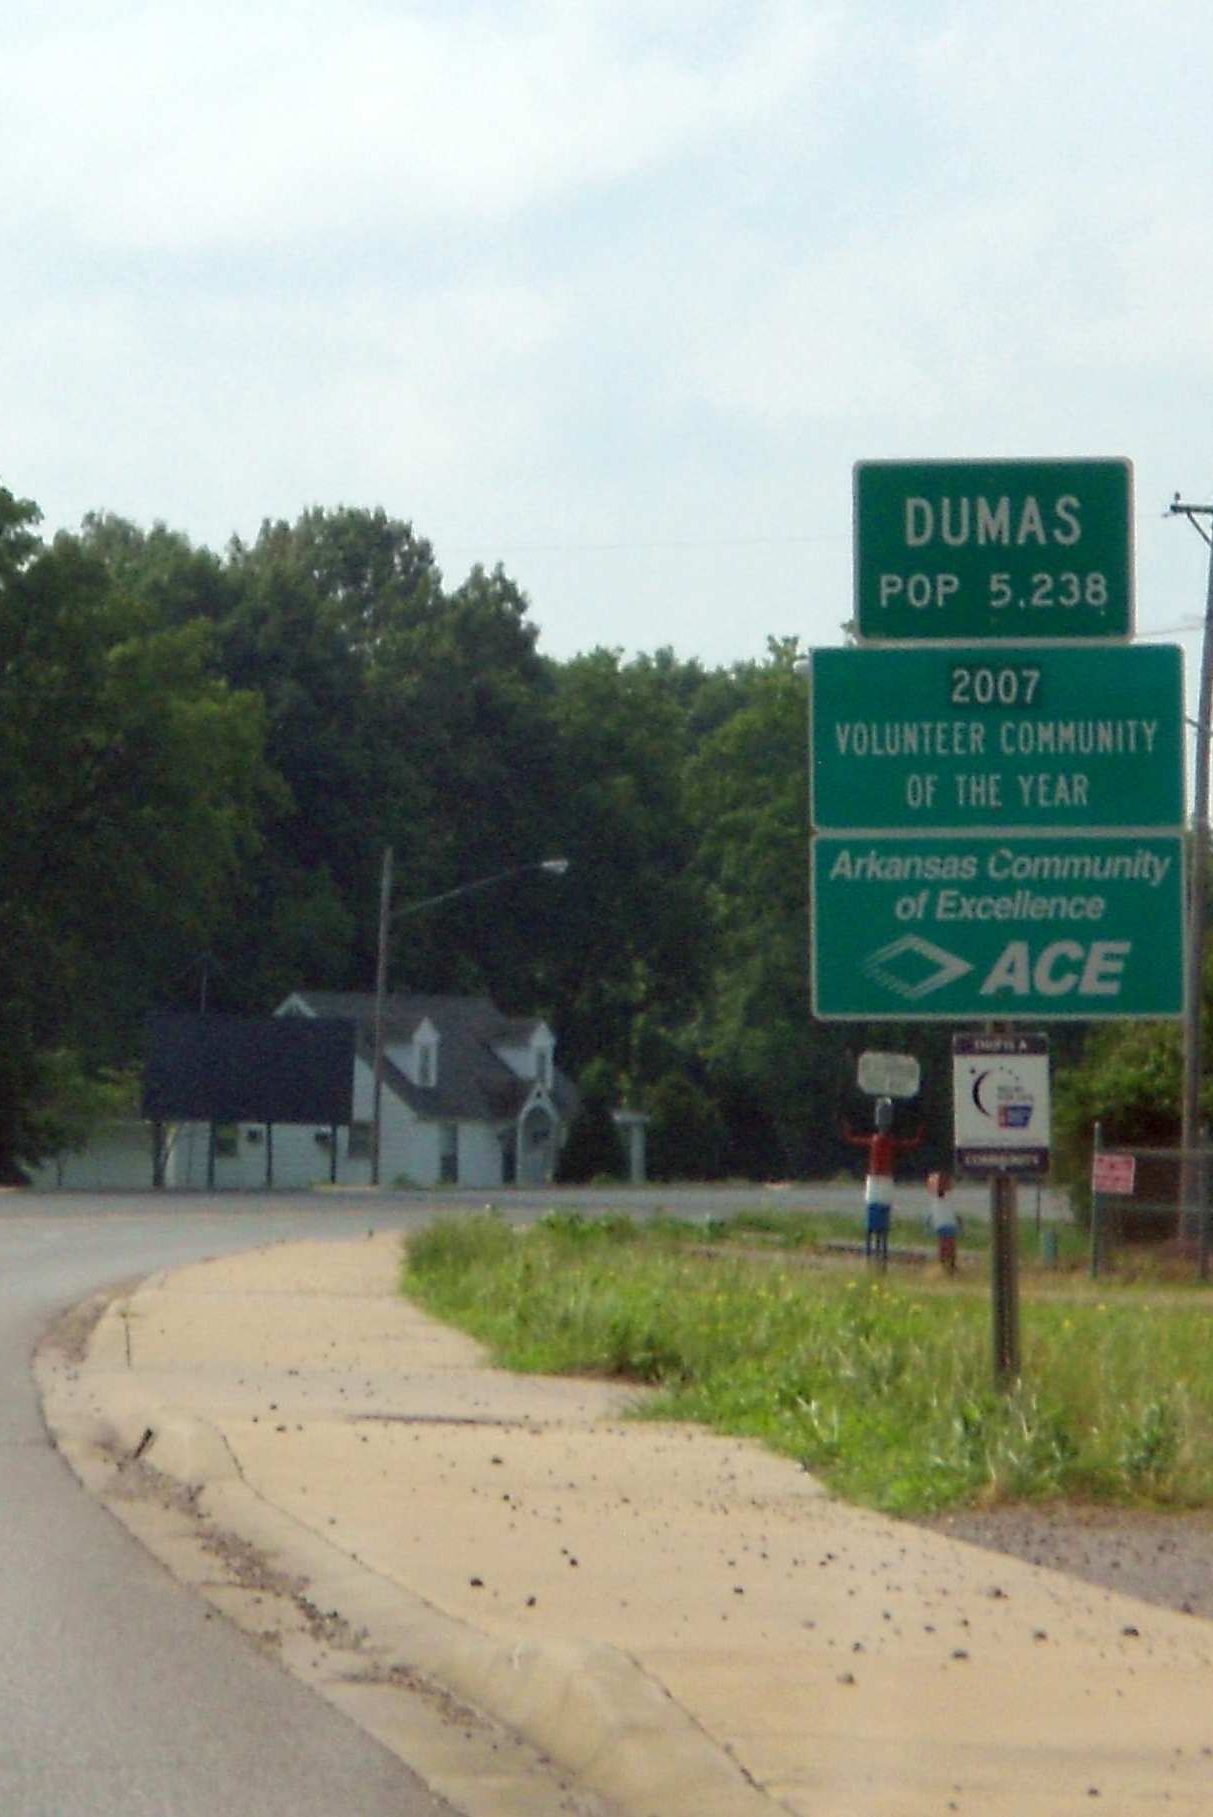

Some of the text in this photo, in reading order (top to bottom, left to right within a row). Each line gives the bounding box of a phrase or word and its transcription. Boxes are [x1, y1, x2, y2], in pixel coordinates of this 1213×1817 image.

[905, 494, 1082, 547] DUMAS
[880, 574, 960, 608] POP
[952, 669, 1041, 704] 2007
[836, 719, 1158, 757] VOLUNTEER COMMUNITY
[907, 773, 1090, 808] OF THE YEAR
[830, 848, 1171, 887] Arkansas Community
[896, 888, 1106, 920] of Excellence
[980, 939, 1131, 996] ACE
